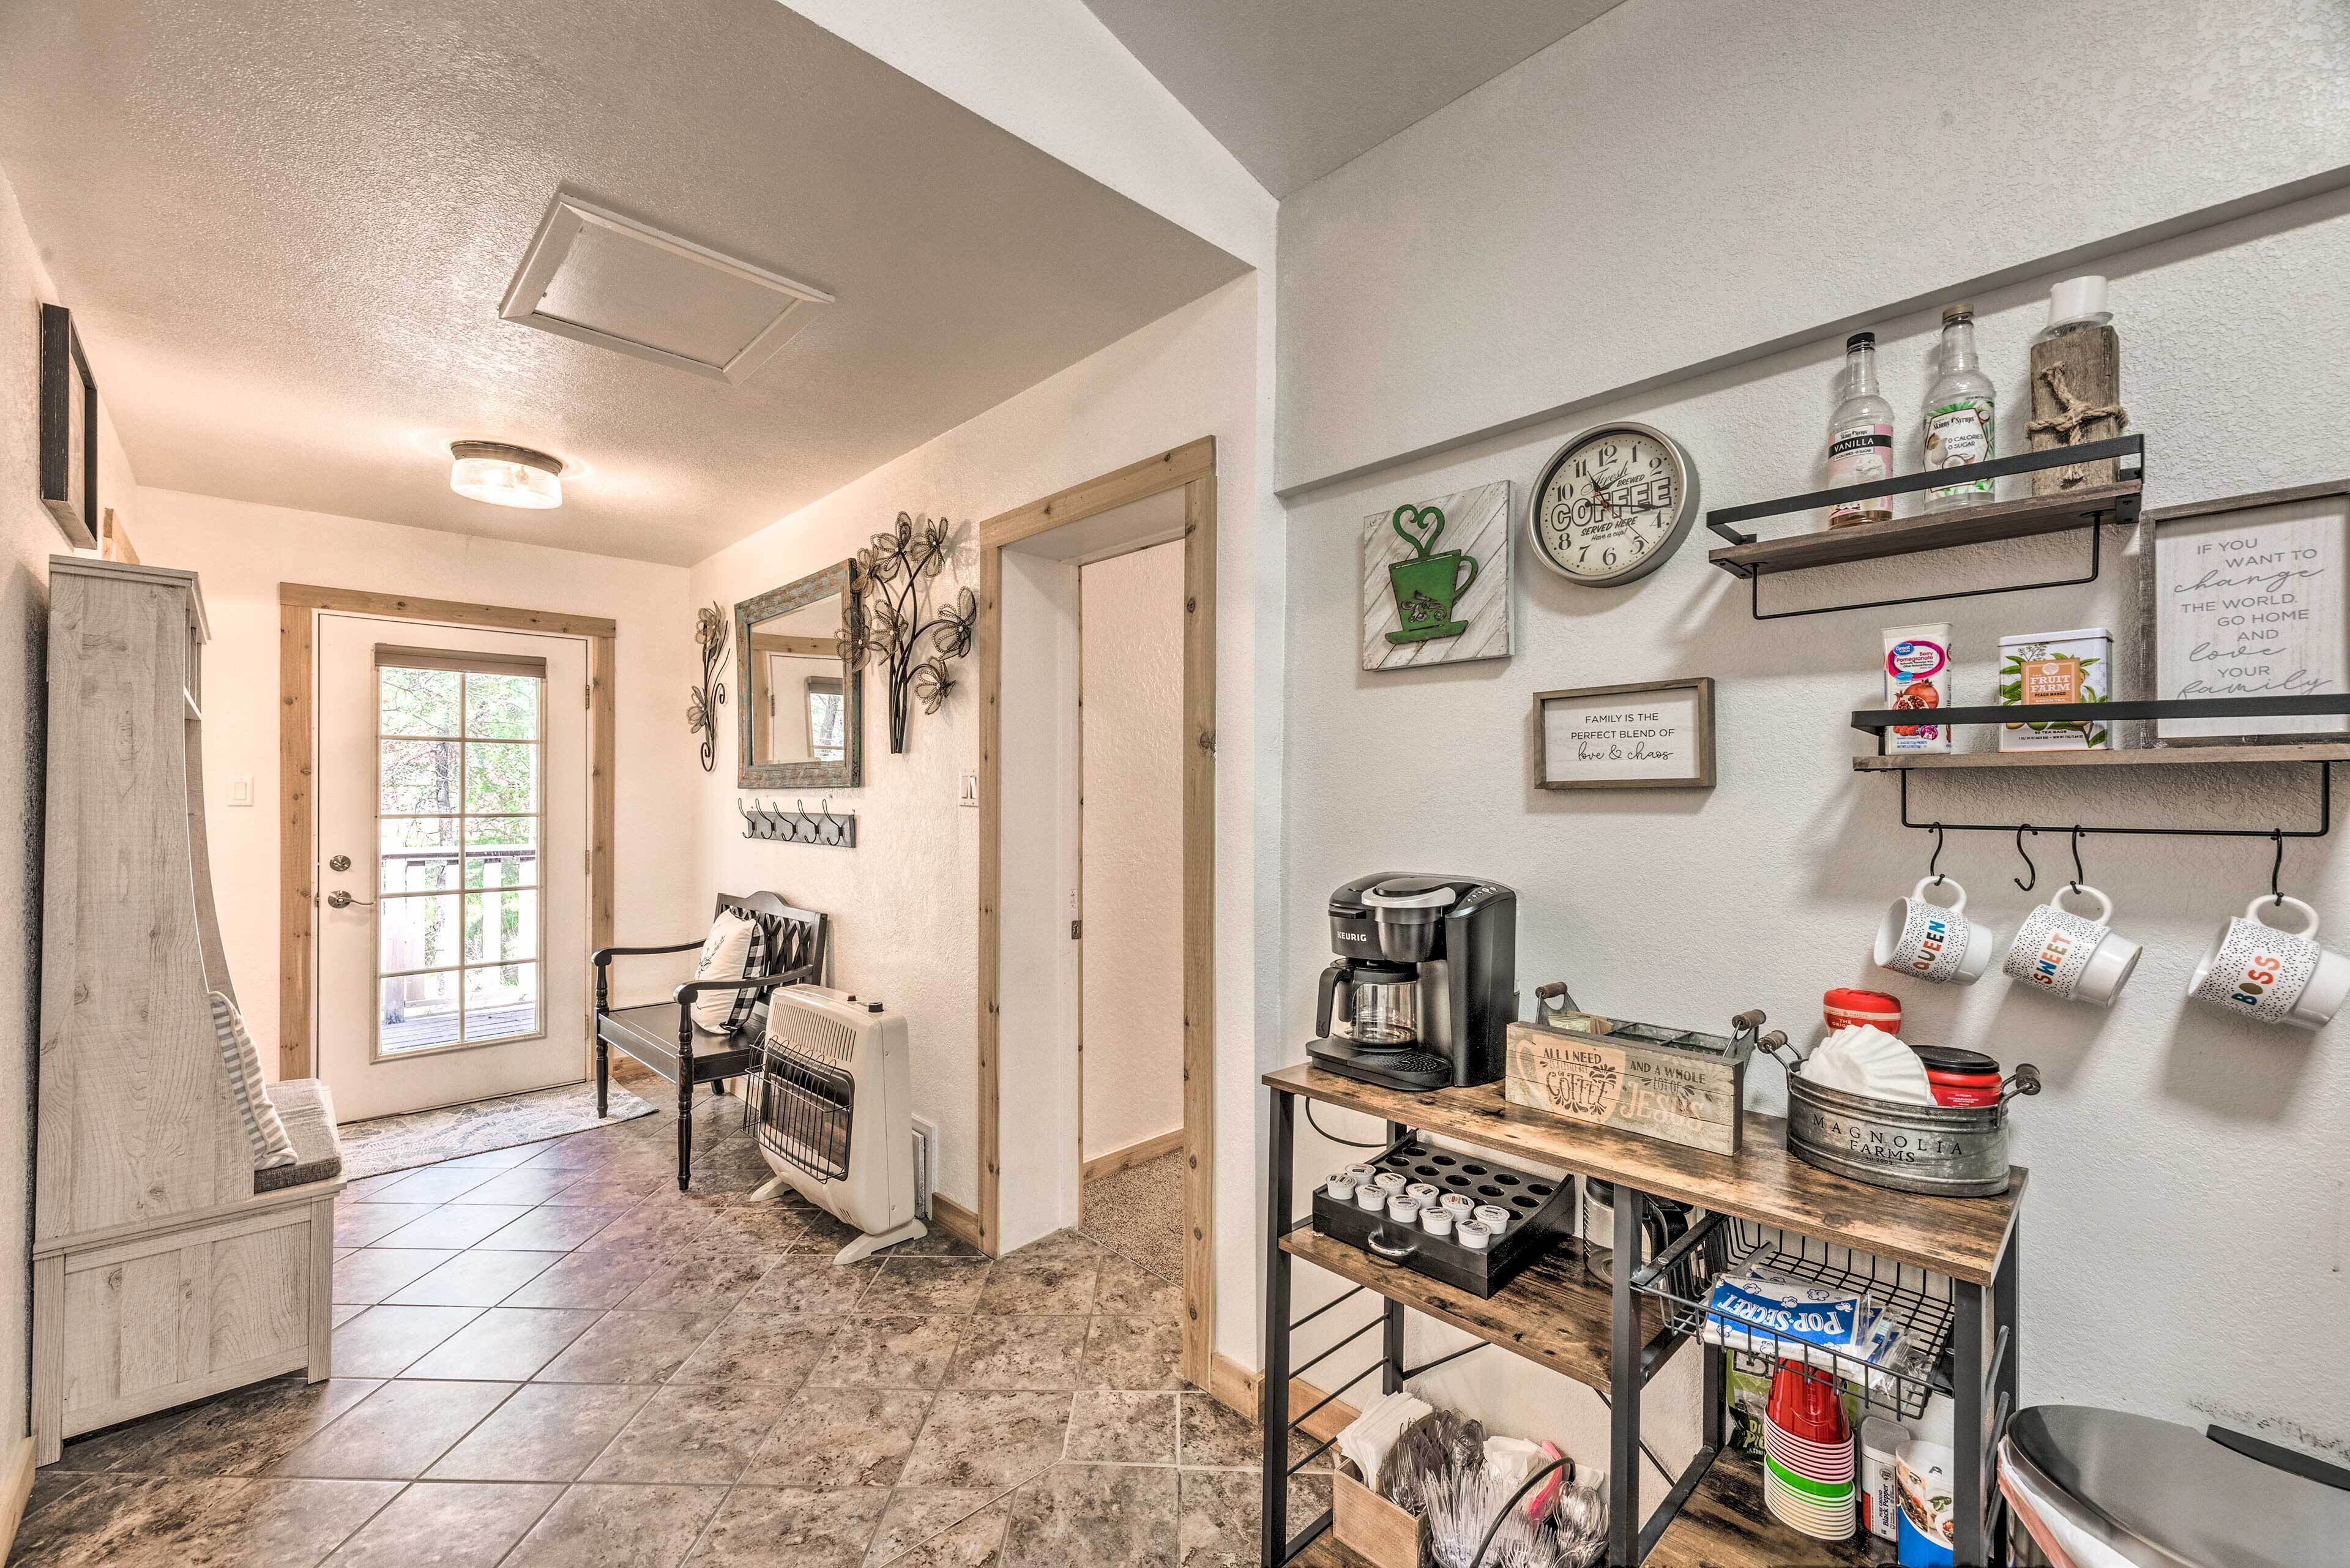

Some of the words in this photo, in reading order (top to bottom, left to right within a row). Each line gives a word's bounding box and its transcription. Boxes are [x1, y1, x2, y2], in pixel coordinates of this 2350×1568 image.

[1631, 444, 1638, 463] 1
[1834, 438, 1874, 452] VANILLA
[1598, 444, 1619, 468] 12
[1575, 459, 1587, 478] 11
[1649, 457, 1663, 477] 2
[1616, 474, 1645, 487] BREWED
[1557, 483, 1573, 502] 10
[1551, 477, 1673, 532] COFFEE
[1581, 522, 1614, 537] SERVED
[1615, 517, 1638, 531] HERE
[1649, 510, 1665, 529] 4
[1557, 532, 1572, 551] 8
[1613, 528, 1627, 537] cup!
[1578, 545, 1591, 563] 7
[1630, 536, 1645, 554] 5
[2197, 543, 2214, 555] IF
[2219, 538, 2258, 552] YOU
[1602, 547, 1617, 566] 6
[2225, 552, 2286, 568] WANT
[2292, 548, 2318, 561] TO
[2174, 568, 2325, 593] change
[2181, 602, 2216, 613] THE
[2217, 615, 2245, 627] GO
[2252, 609, 2310, 624] HOME
[2237, 629, 2279, 641] AND
[2188, 641, 2287, 662] love
[2030, 675, 2071, 685] FRUIT
[2217, 666, 2270, 678] YOUR
[2030, 683, 2071, 693] FARM
[1585, 714, 1622, 724] FAMILY
[1625, 714, 1634, 722] IS
[1638, 712, 1658, 722] THE
[1571, 731, 1616, 739] PERFECT
[1619, 730, 1655, 738] BLEND
[1578, 741, 1604, 761] love
[1608, 744, 1622, 760] &
[1627, 741, 1674, 760] chaos
[1337, 931, 1367, 942] KEURIG
[1915, 920, 1946, 971] QUEEN
[2033, 933, 2072, 985] SWEET
[2231, 955, 2281, 1006] BOSS
[1544, 1048, 1562, 1059] ALL
[1565, 1050, 1569, 1060] I
[1573, 1051, 1602, 1064] NEED
[1630, 1061, 1651, 1072] AND
[1654, 1065, 1660, 1075] A
[1665, 1067, 1706, 1085] WHOLE
[1546, 1071, 1614, 1109] COFFEE
[1654, 1077, 1668, 1091] LOT
[1670, 1080, 1681, 1094] OF
[1813, 1114, 1963, 1155] MAGNOLIA
[1850, 1140, 1915, 1162] FARMS
